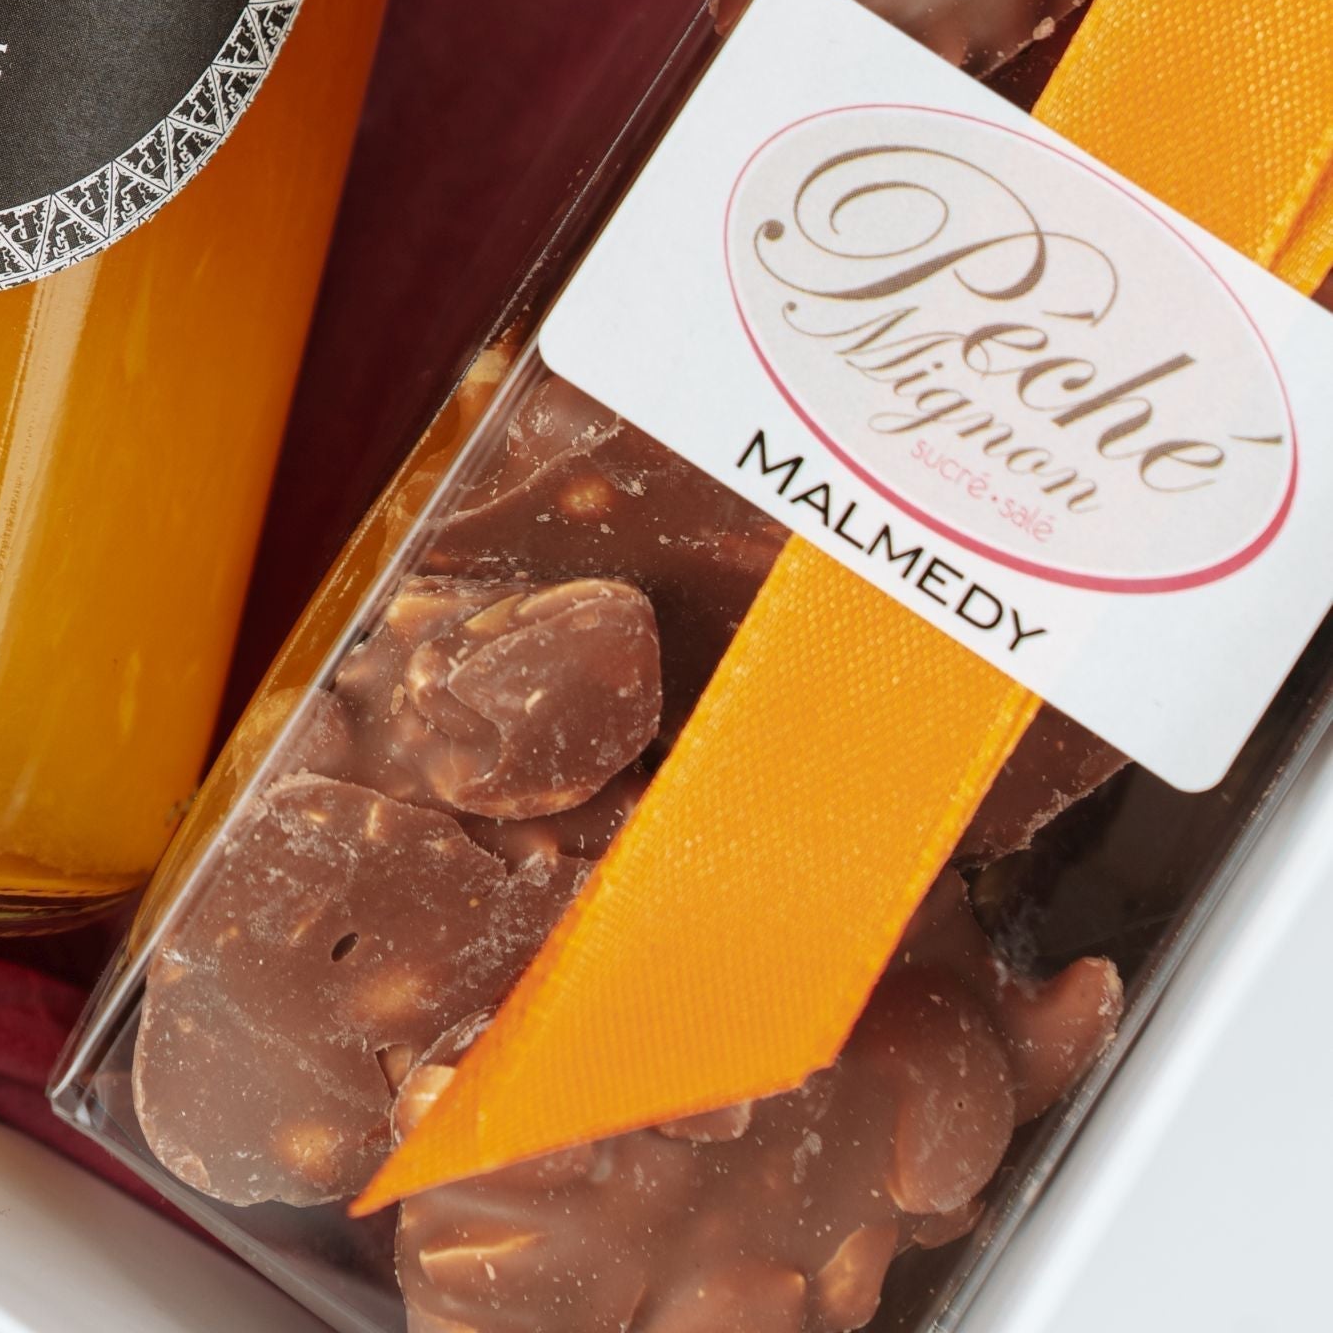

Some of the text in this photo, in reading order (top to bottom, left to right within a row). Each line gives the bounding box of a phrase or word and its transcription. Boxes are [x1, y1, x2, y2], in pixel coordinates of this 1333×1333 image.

[753, 144, 1283, 493] Péché
[781, 301, 1103, 515] Mignon
[734, 429, 1050, 653] MALMEDY
